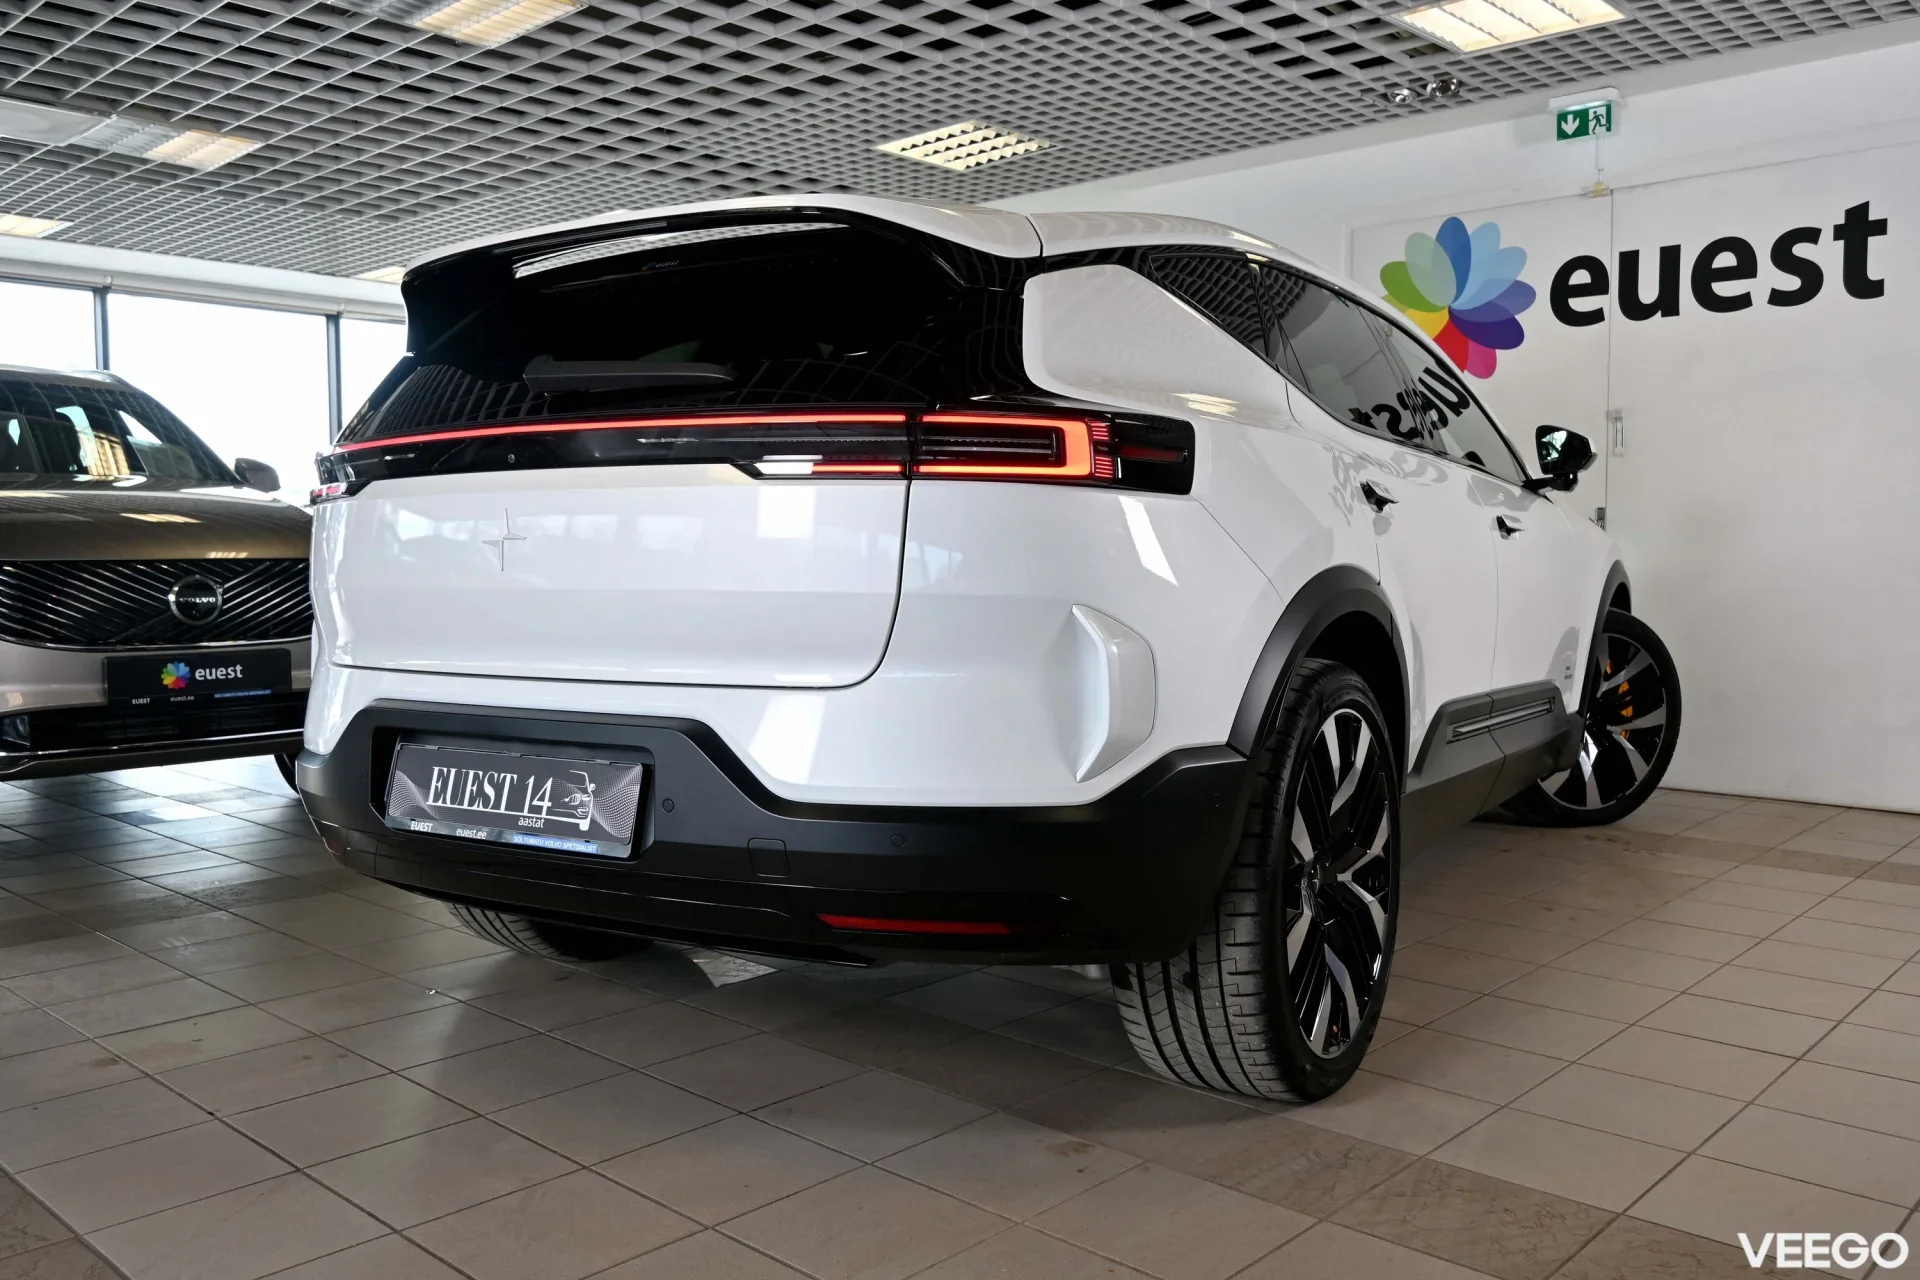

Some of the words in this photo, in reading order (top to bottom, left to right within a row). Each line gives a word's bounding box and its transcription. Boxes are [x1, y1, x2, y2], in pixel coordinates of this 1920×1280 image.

[1549, 200, 1888, 327] euest
[179, 596, 216, 604] VOLVO
[195, 664, 243, 681] euest
[132, 697, 151, 705] EUEST
[170, 694, 195, 702] euest.ee
[426, 766, 517, 814] EUEST
[524, 774, 554, 818] 14
[410, 820, 434, 832] EUEST
[518, 816, 545, 829] aastat
[456, 828, 487, 840] euest.ee
[544, 840, 562, 848] VOLVO
[563, 843, 597, 853] SPETSIALIST
